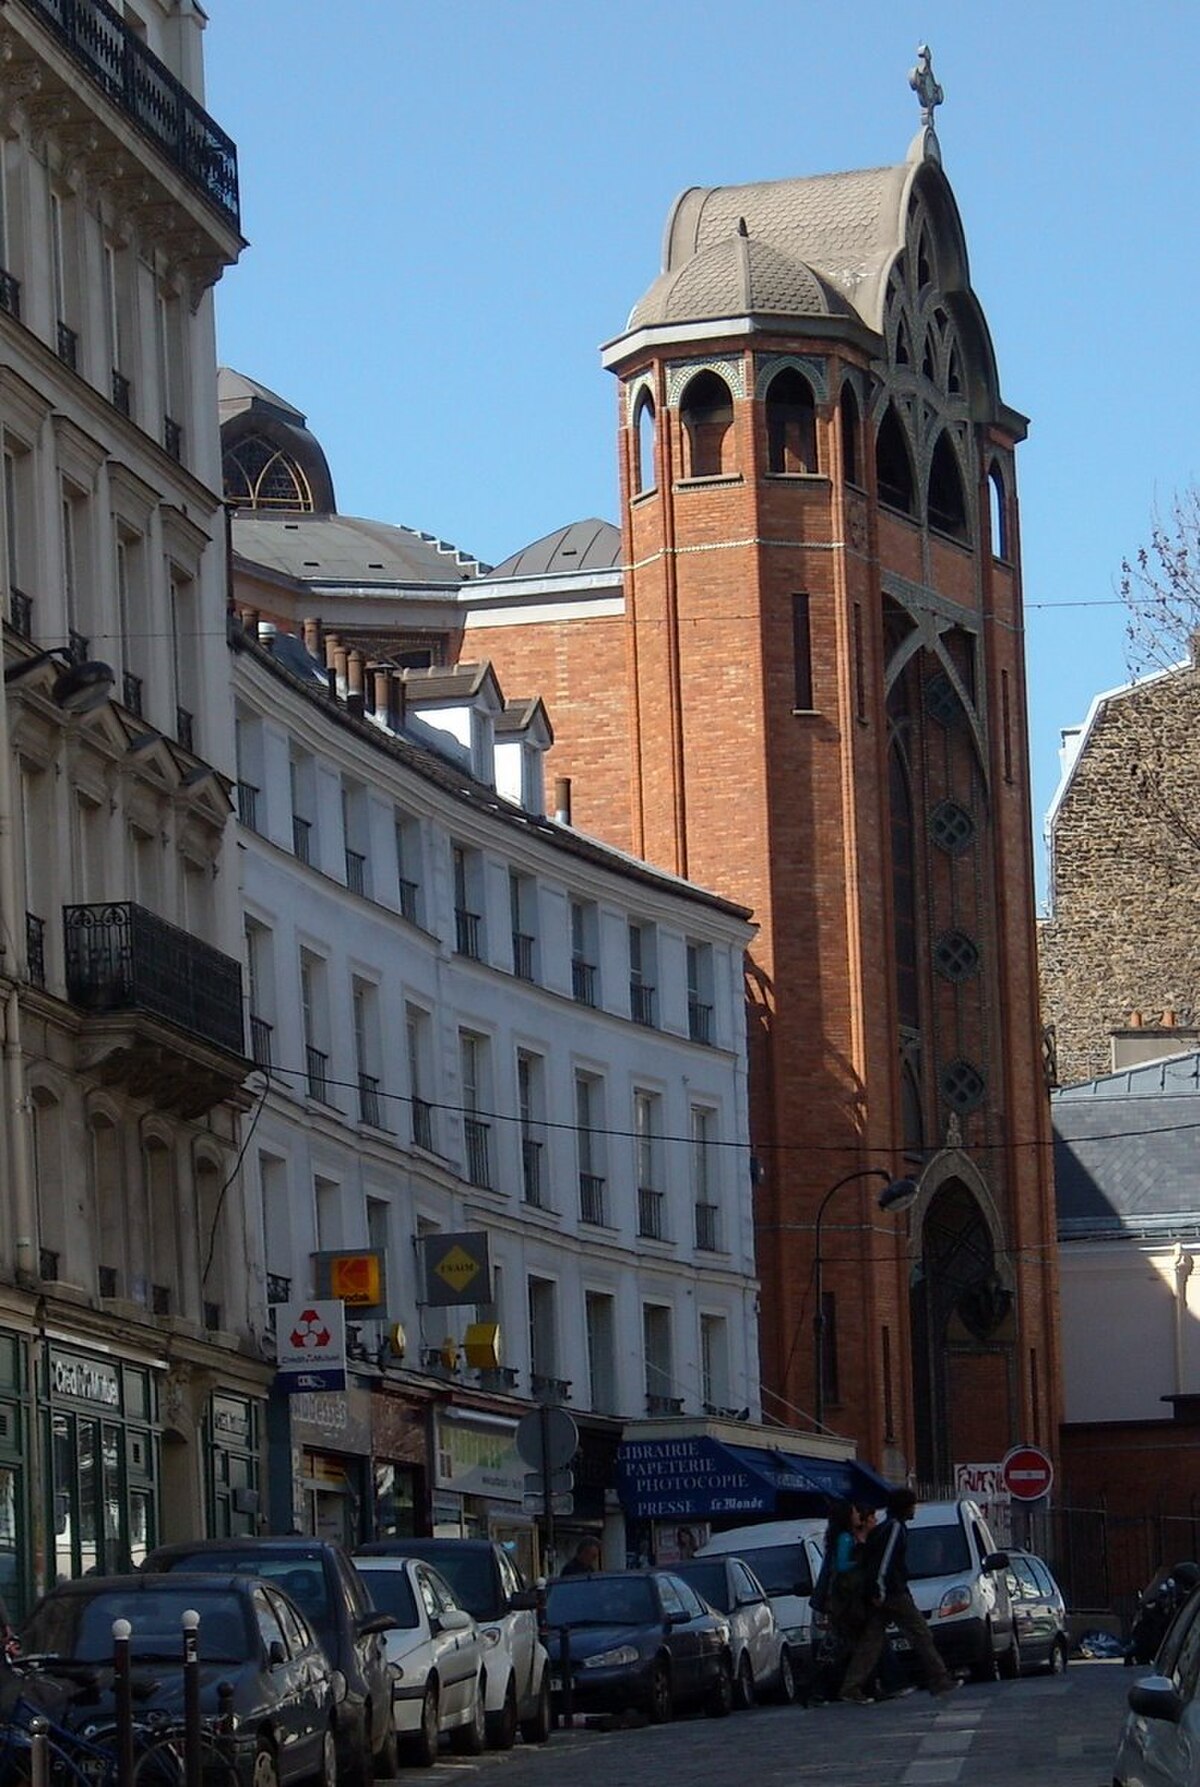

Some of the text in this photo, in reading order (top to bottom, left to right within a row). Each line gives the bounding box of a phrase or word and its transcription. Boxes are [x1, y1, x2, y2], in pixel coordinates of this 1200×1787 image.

[616, 1441, 700, 1461] LIBRAIRIE
[625, 1457, 717, 1477] PAPETERIE
[636, 1473, 750, 1493] PHOTOCOPIE
[637, 1499, 696, 1516] PRESSE
[723, 1497, 763, 1510] Monde
